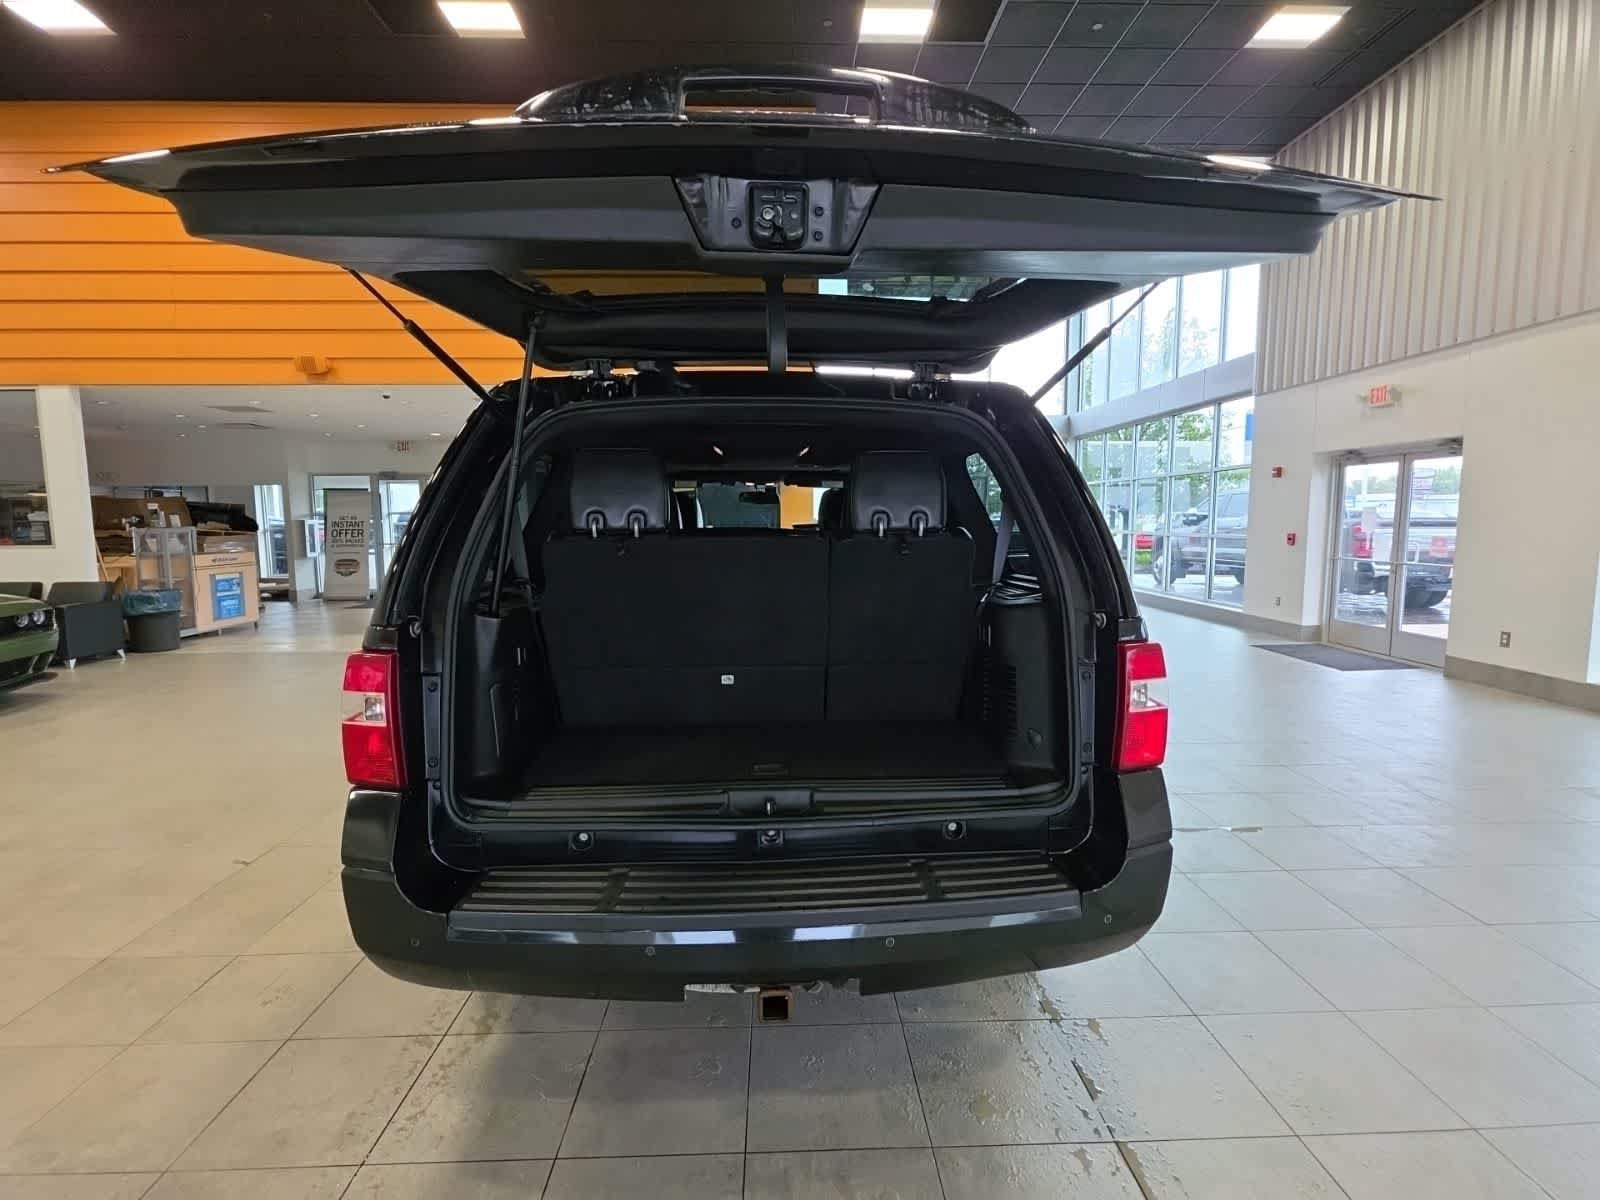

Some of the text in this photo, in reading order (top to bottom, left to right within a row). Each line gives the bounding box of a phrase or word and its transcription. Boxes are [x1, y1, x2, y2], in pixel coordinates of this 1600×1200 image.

[1370, 385, 1388, 405] EXIT
[331, 520, 365, 529] INSTANT
[331, 529, 365, 538] OFFER
